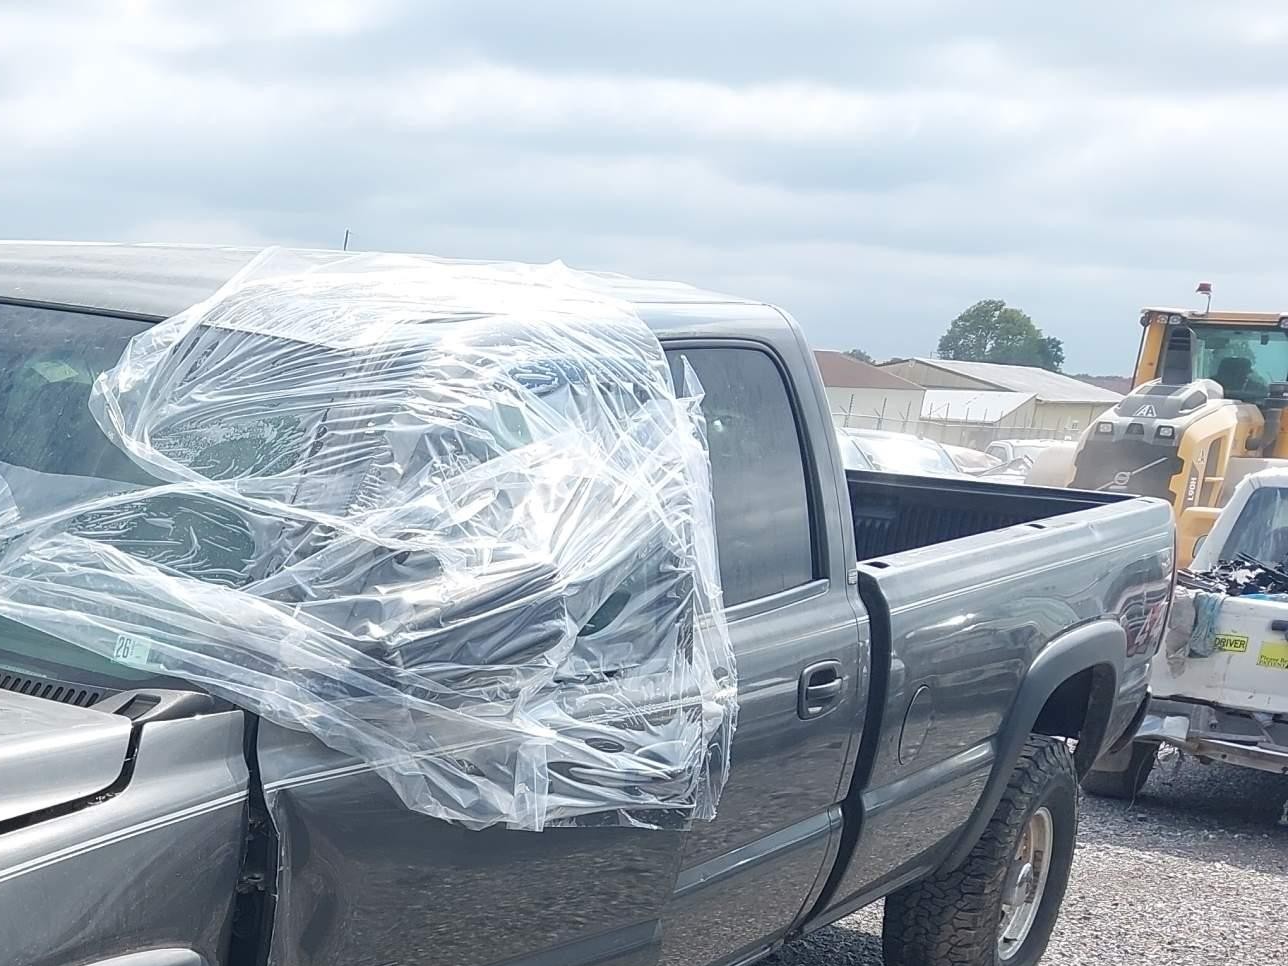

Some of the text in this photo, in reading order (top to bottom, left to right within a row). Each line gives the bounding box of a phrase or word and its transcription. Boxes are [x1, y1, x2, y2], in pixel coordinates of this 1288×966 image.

[1186, 477, 1198, 501] L90H
[115, 636, 132, 659] 26
[1215, 637, 1246, 648] DRIVER
